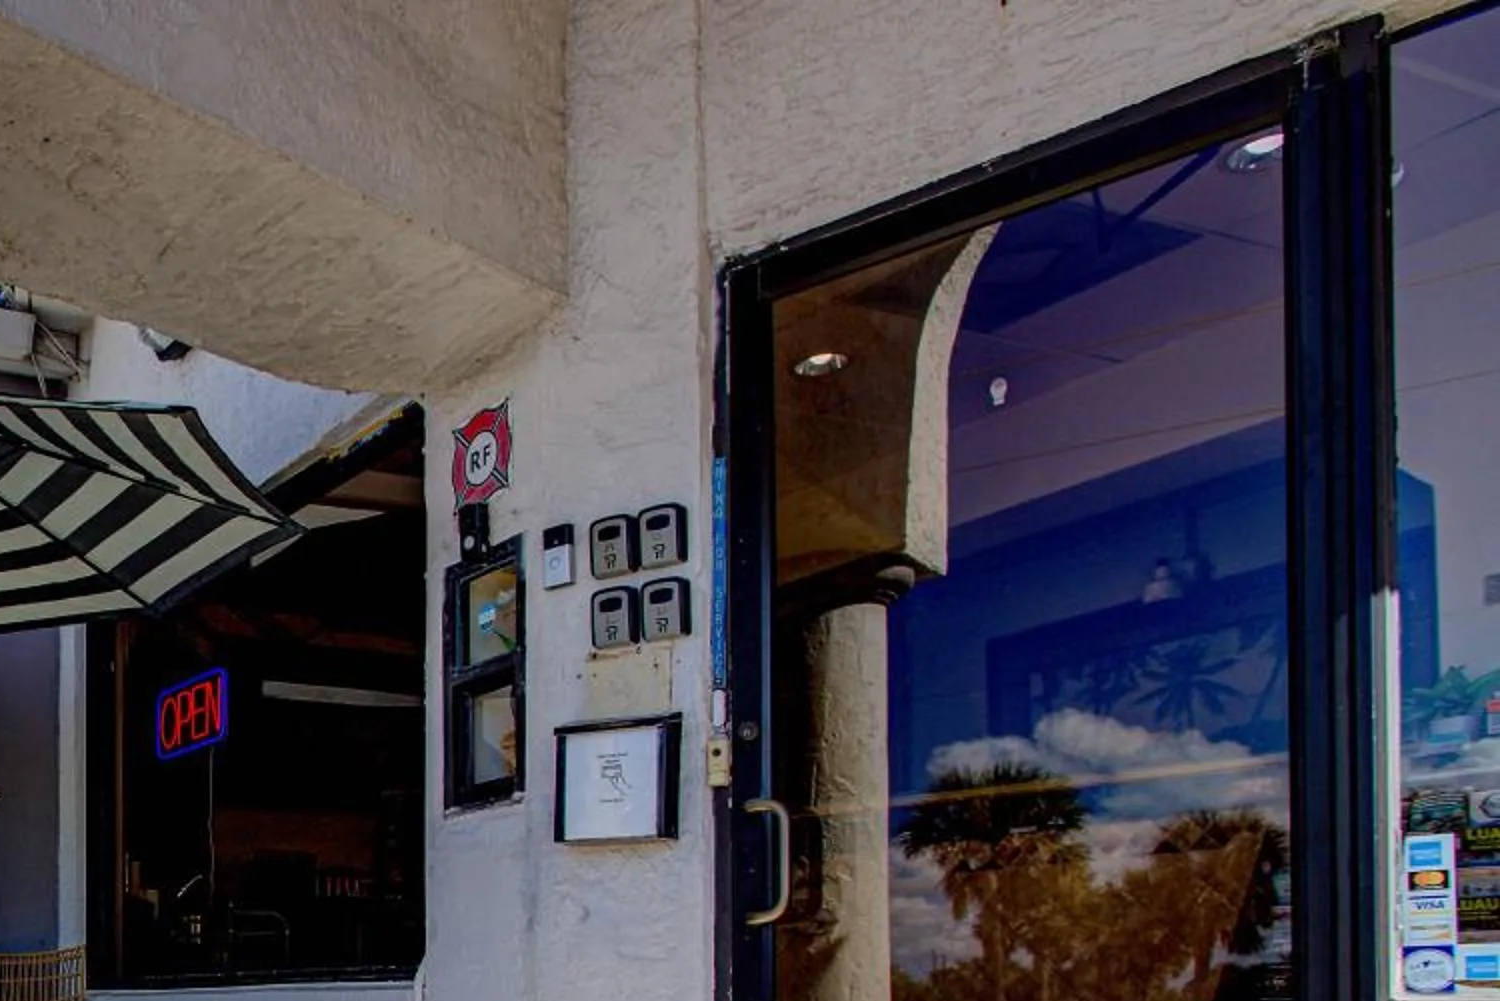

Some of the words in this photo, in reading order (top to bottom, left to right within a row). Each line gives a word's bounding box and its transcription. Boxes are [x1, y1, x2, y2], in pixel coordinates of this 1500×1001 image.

[470, 442, 492, 473] RF
[160, 675, 222, 751] OPEN
[1414, 900, 1445, 910] VISA
[1458, 899, 1499, 910] UAU
